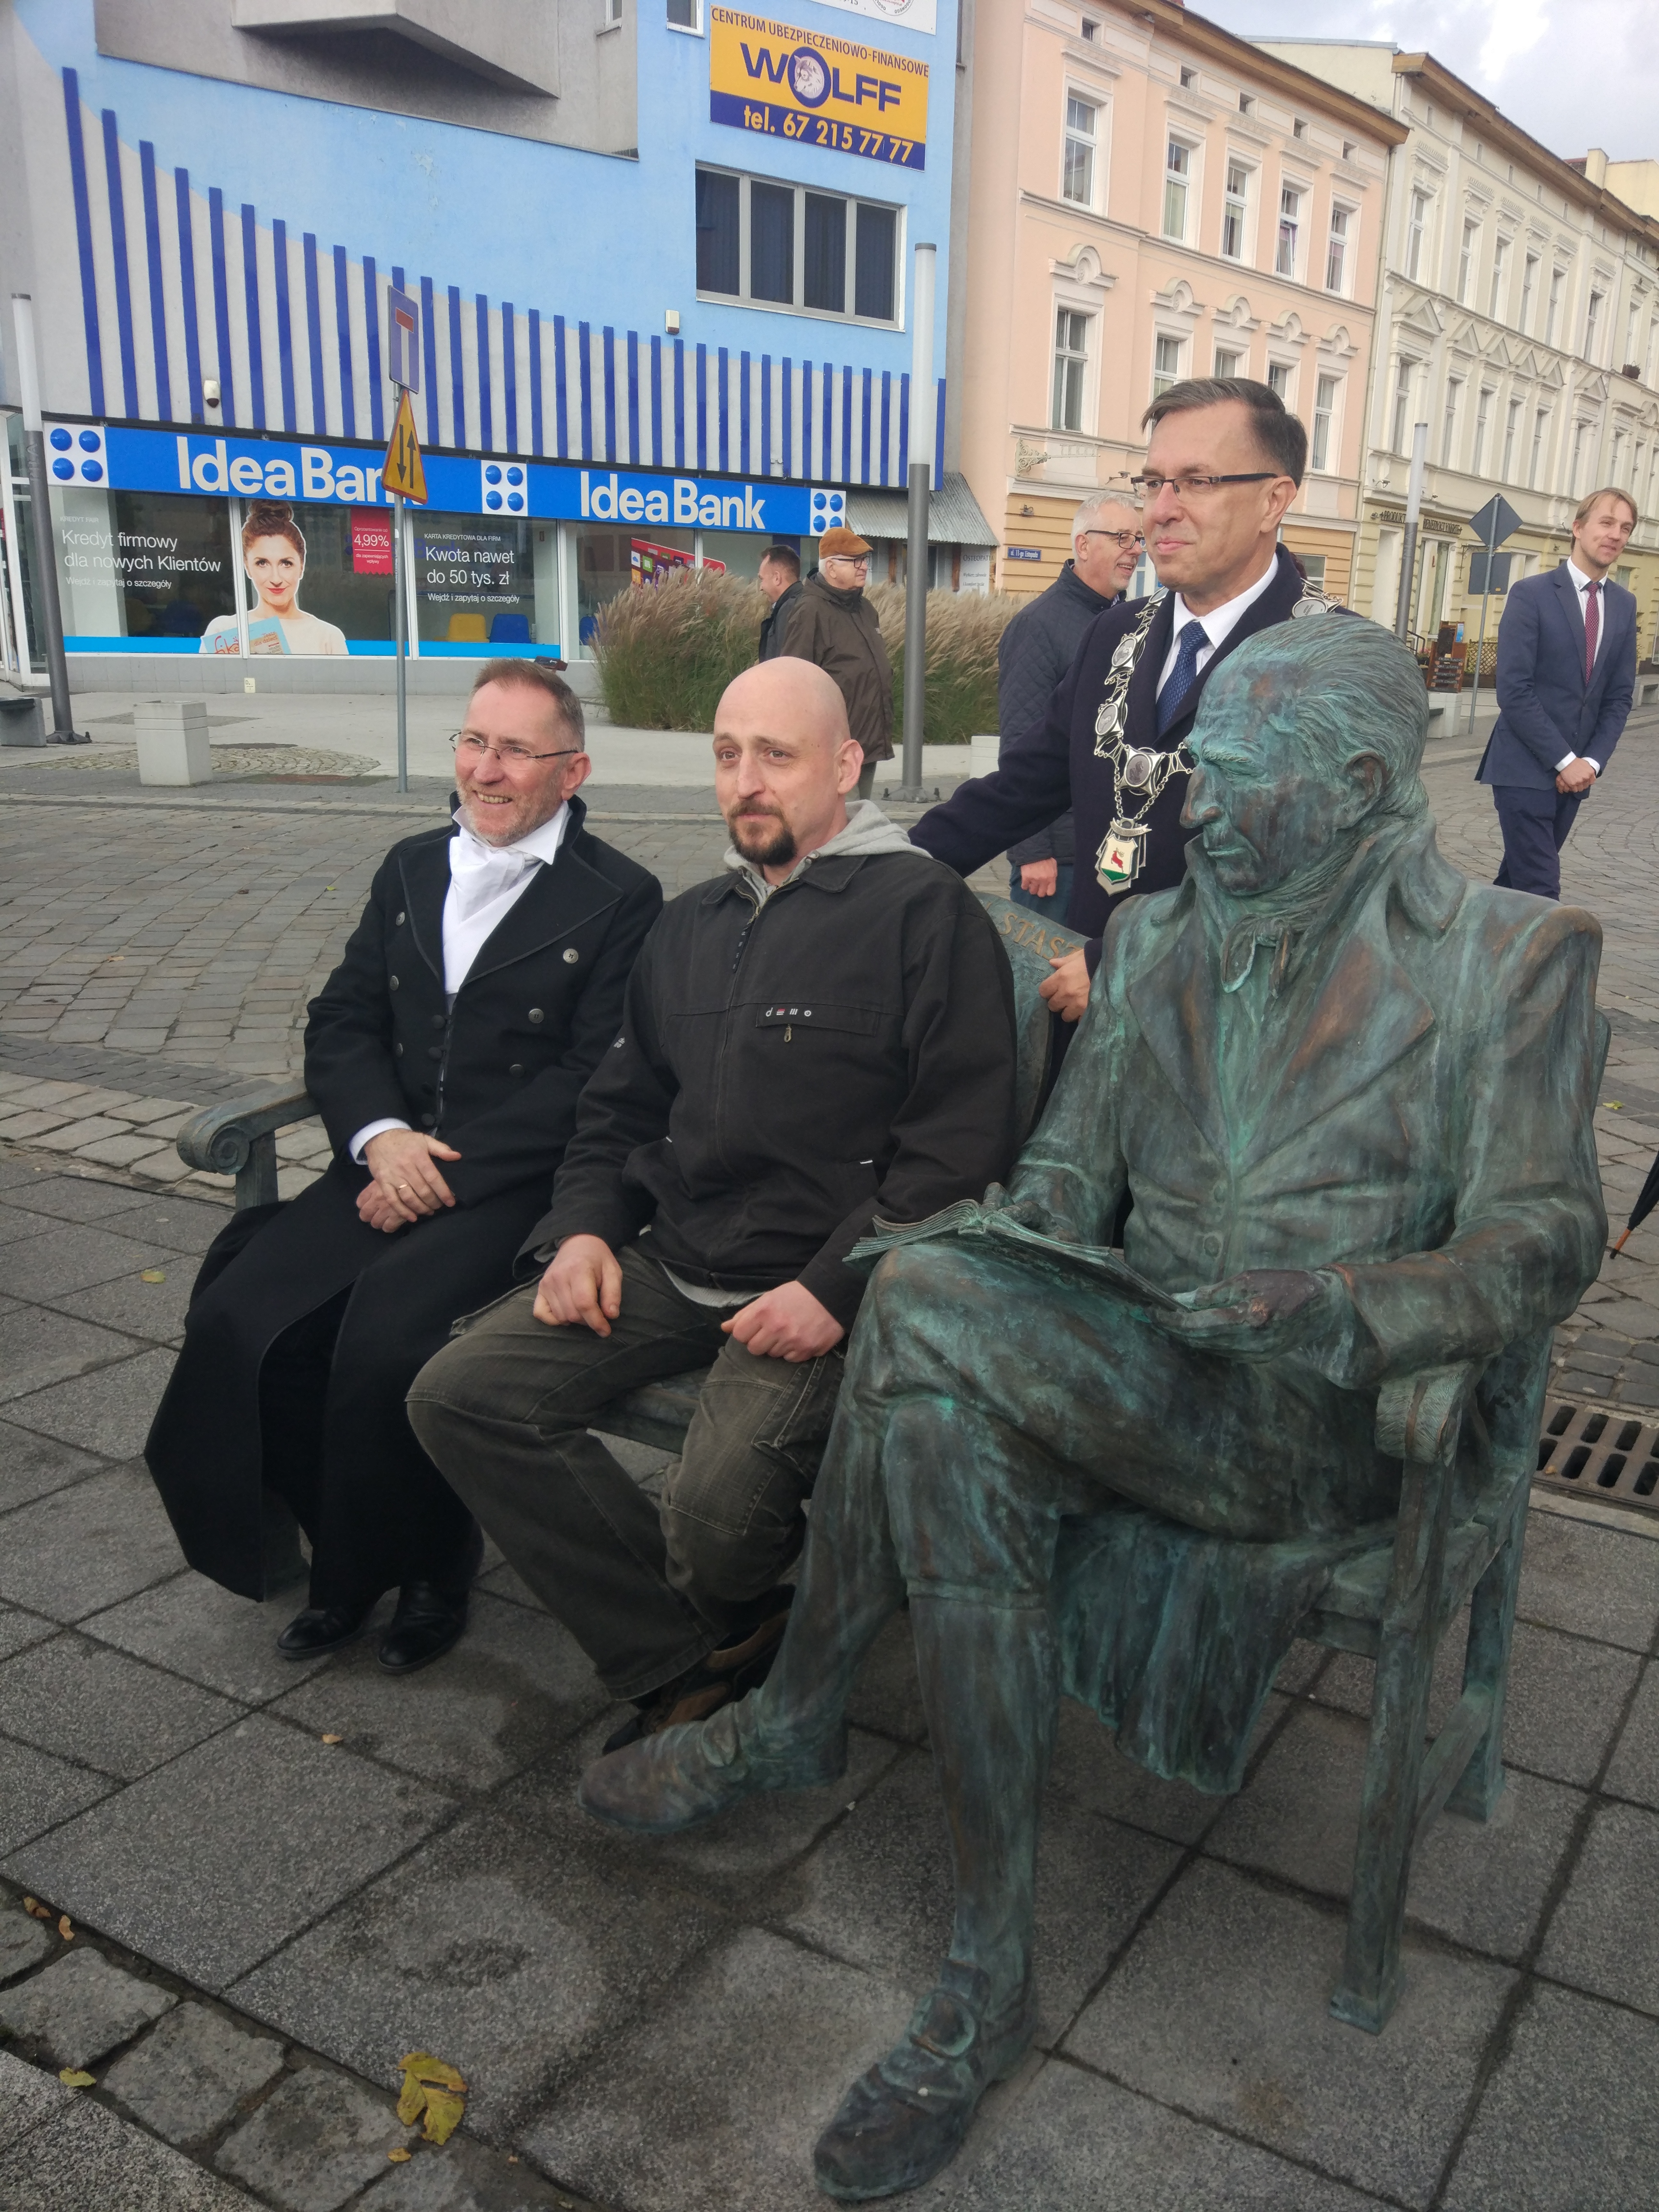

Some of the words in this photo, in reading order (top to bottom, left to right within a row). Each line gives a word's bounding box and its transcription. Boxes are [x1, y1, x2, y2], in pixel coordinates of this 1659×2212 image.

[712, 9, 766, 33] CENTRUM
[769, 24, 929, 77] UBEZPIECZENIOWO-FINANSOWE
[740, 42, 901, 113] WOLFF
[744, 105, 775, 132] tel.
[783, 113, 810, 139] 67
[816, 120, 853, 149] 215
[859, 130, 884, 158] 77
[890, 138, 914, 163] 77
[62, 529, 114, 549] Kredyt
[118, 532, 178, 552] firmowy
[354, 534, 389, 547] 4,99%
[64, 552, 88, 567] dla
[93, 555, 153, 572] nowych
[158, 555, 221, 572] Klientów
[426, 546, 470, 562] Kwota
[474, 550, 515, 564] nawet
[66, 577, 91, 587] Wejdź
[97, 577, 125, 588] zapytaj
[427, 569, 445, 583] do
[449, 570, 467, 584] 50
[470, 571, 494, 588] tys.
[499, 571, 510, 585] zł
[428, 593, 450, 602] Wejdź
[455, 594, 479, 603] zapytaj
